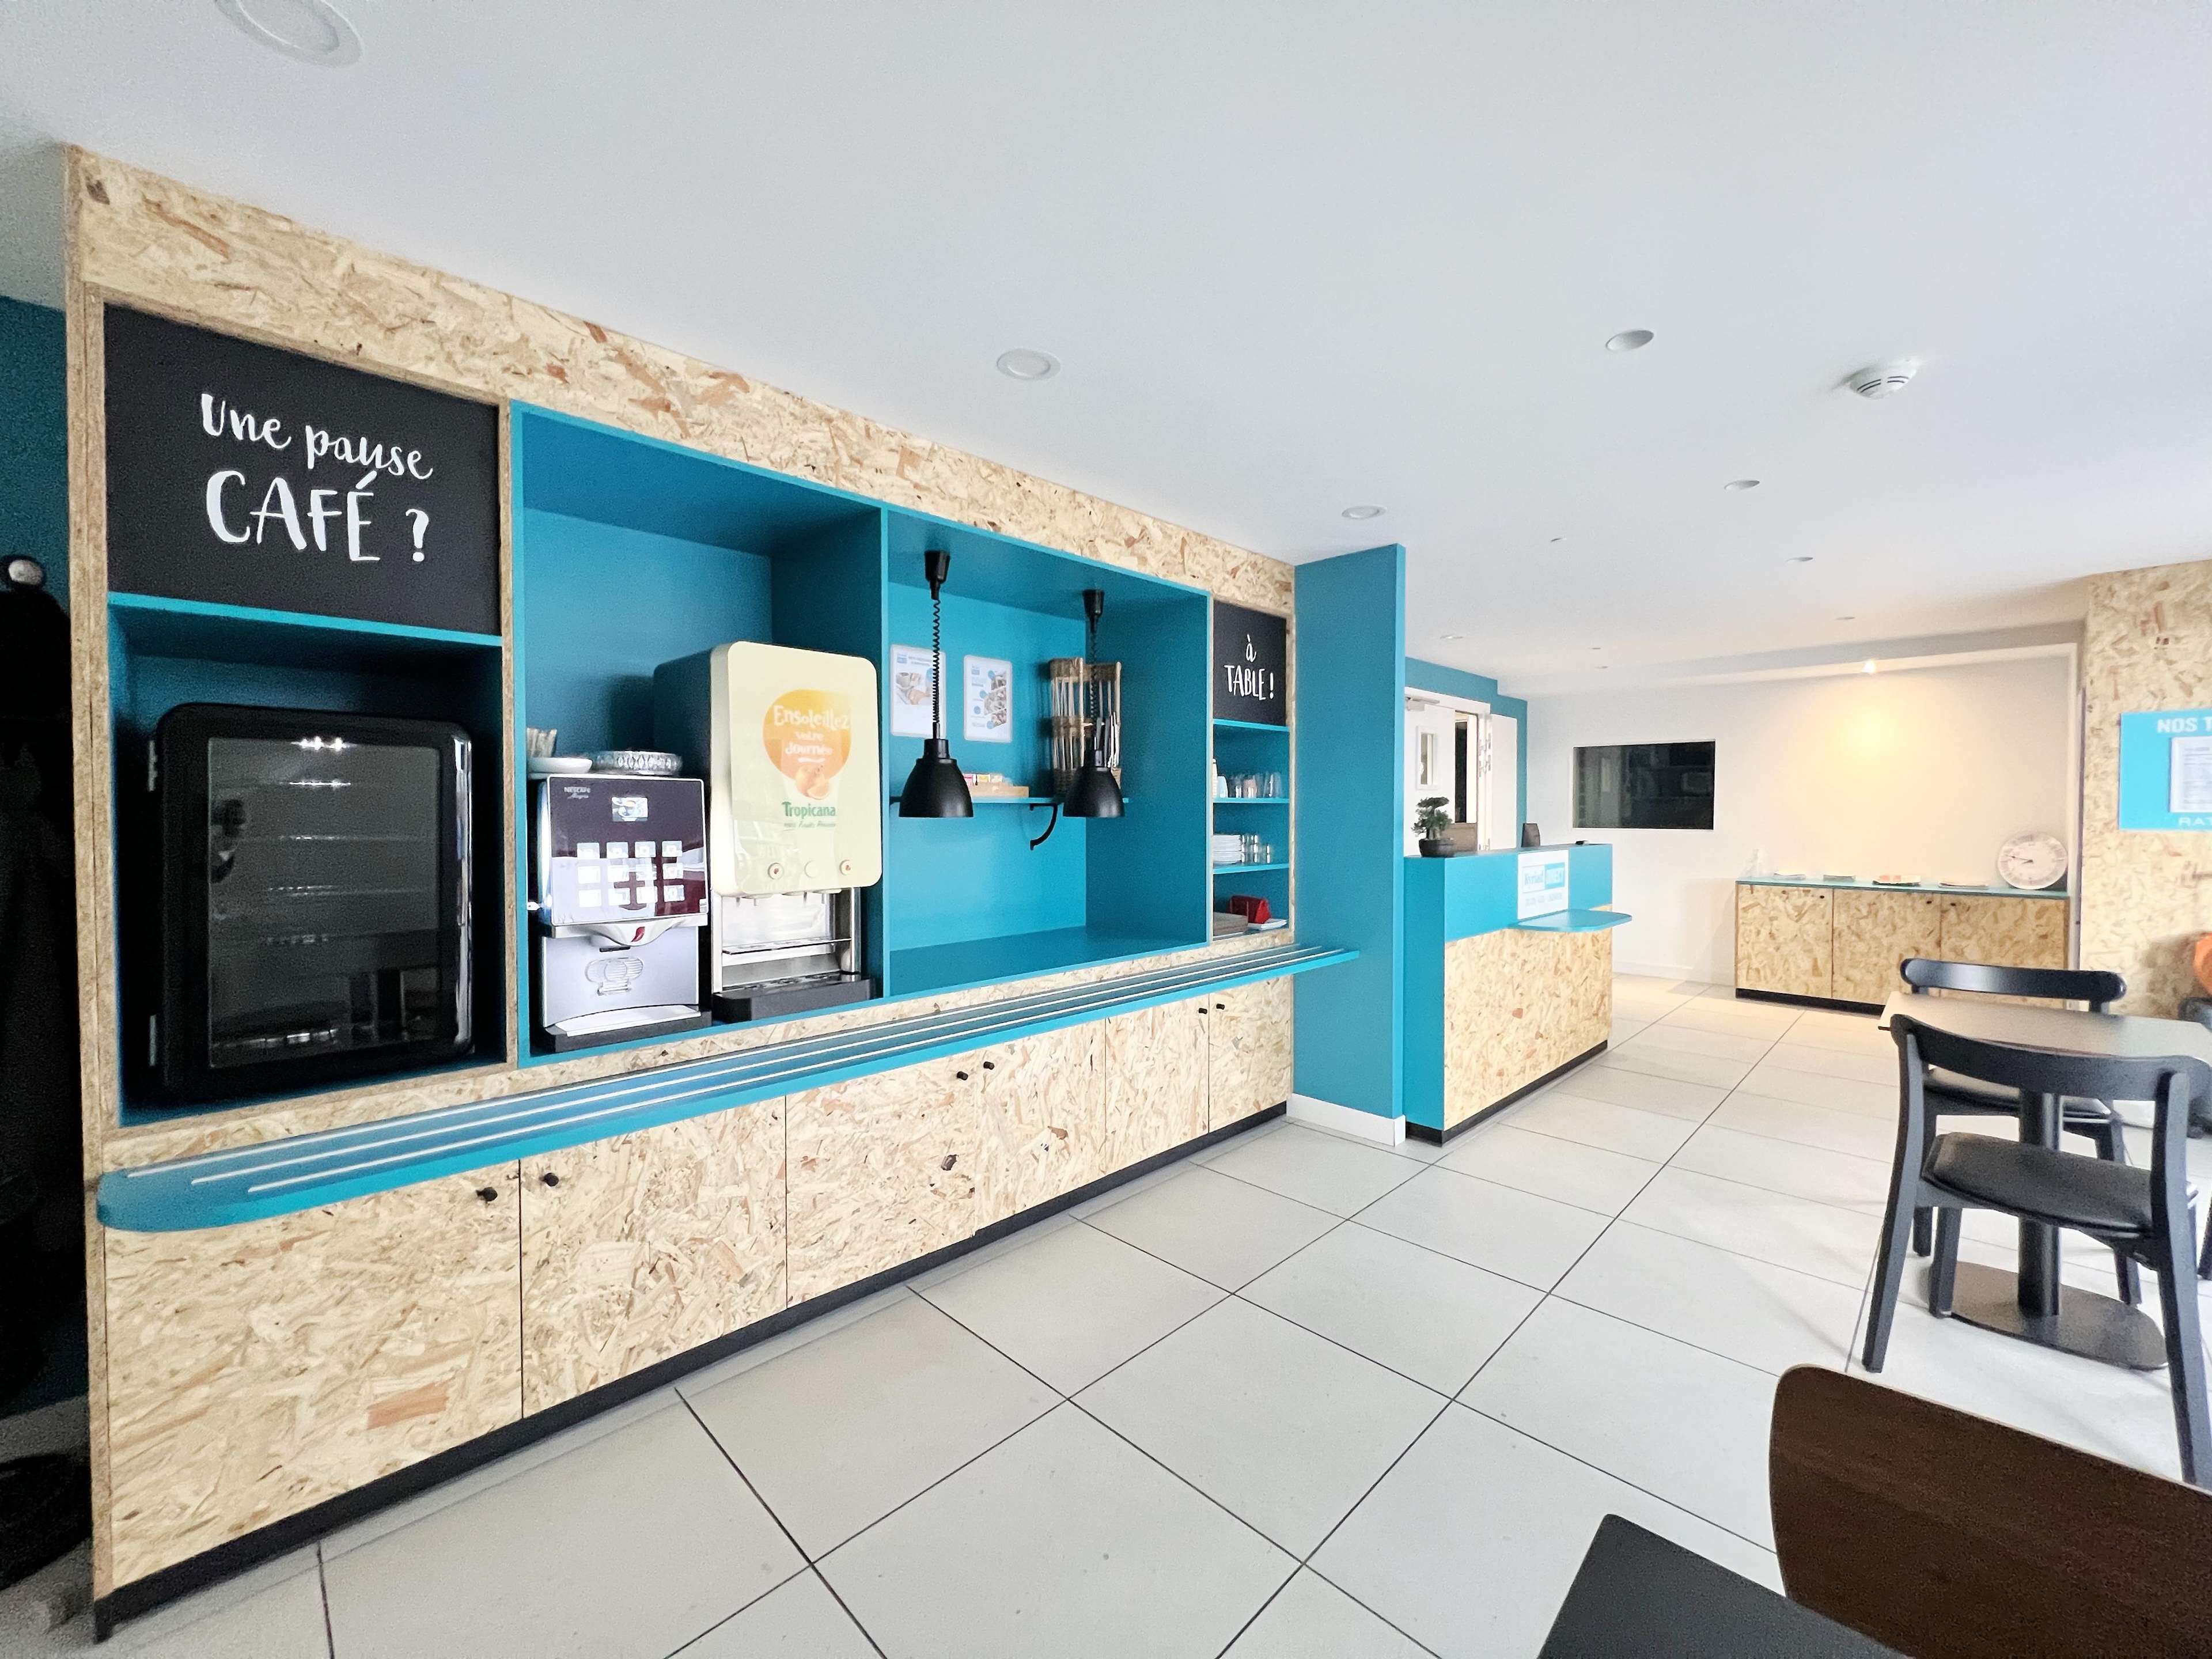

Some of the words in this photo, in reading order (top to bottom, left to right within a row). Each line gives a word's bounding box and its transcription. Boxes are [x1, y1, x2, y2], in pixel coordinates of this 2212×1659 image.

[201, 393, 291, 449] Une
[305, 425, 433, 479] pause
[206, 471, 381, 561] CAFÉ
[405, 509, 430, 562] ?
[1245, 634, 1257, 662] à
[1224, 665, 1266, 700] TABLE
[2157, 717, 2198, 733] NOS
[782, 801, 836, 819] Tropicana
